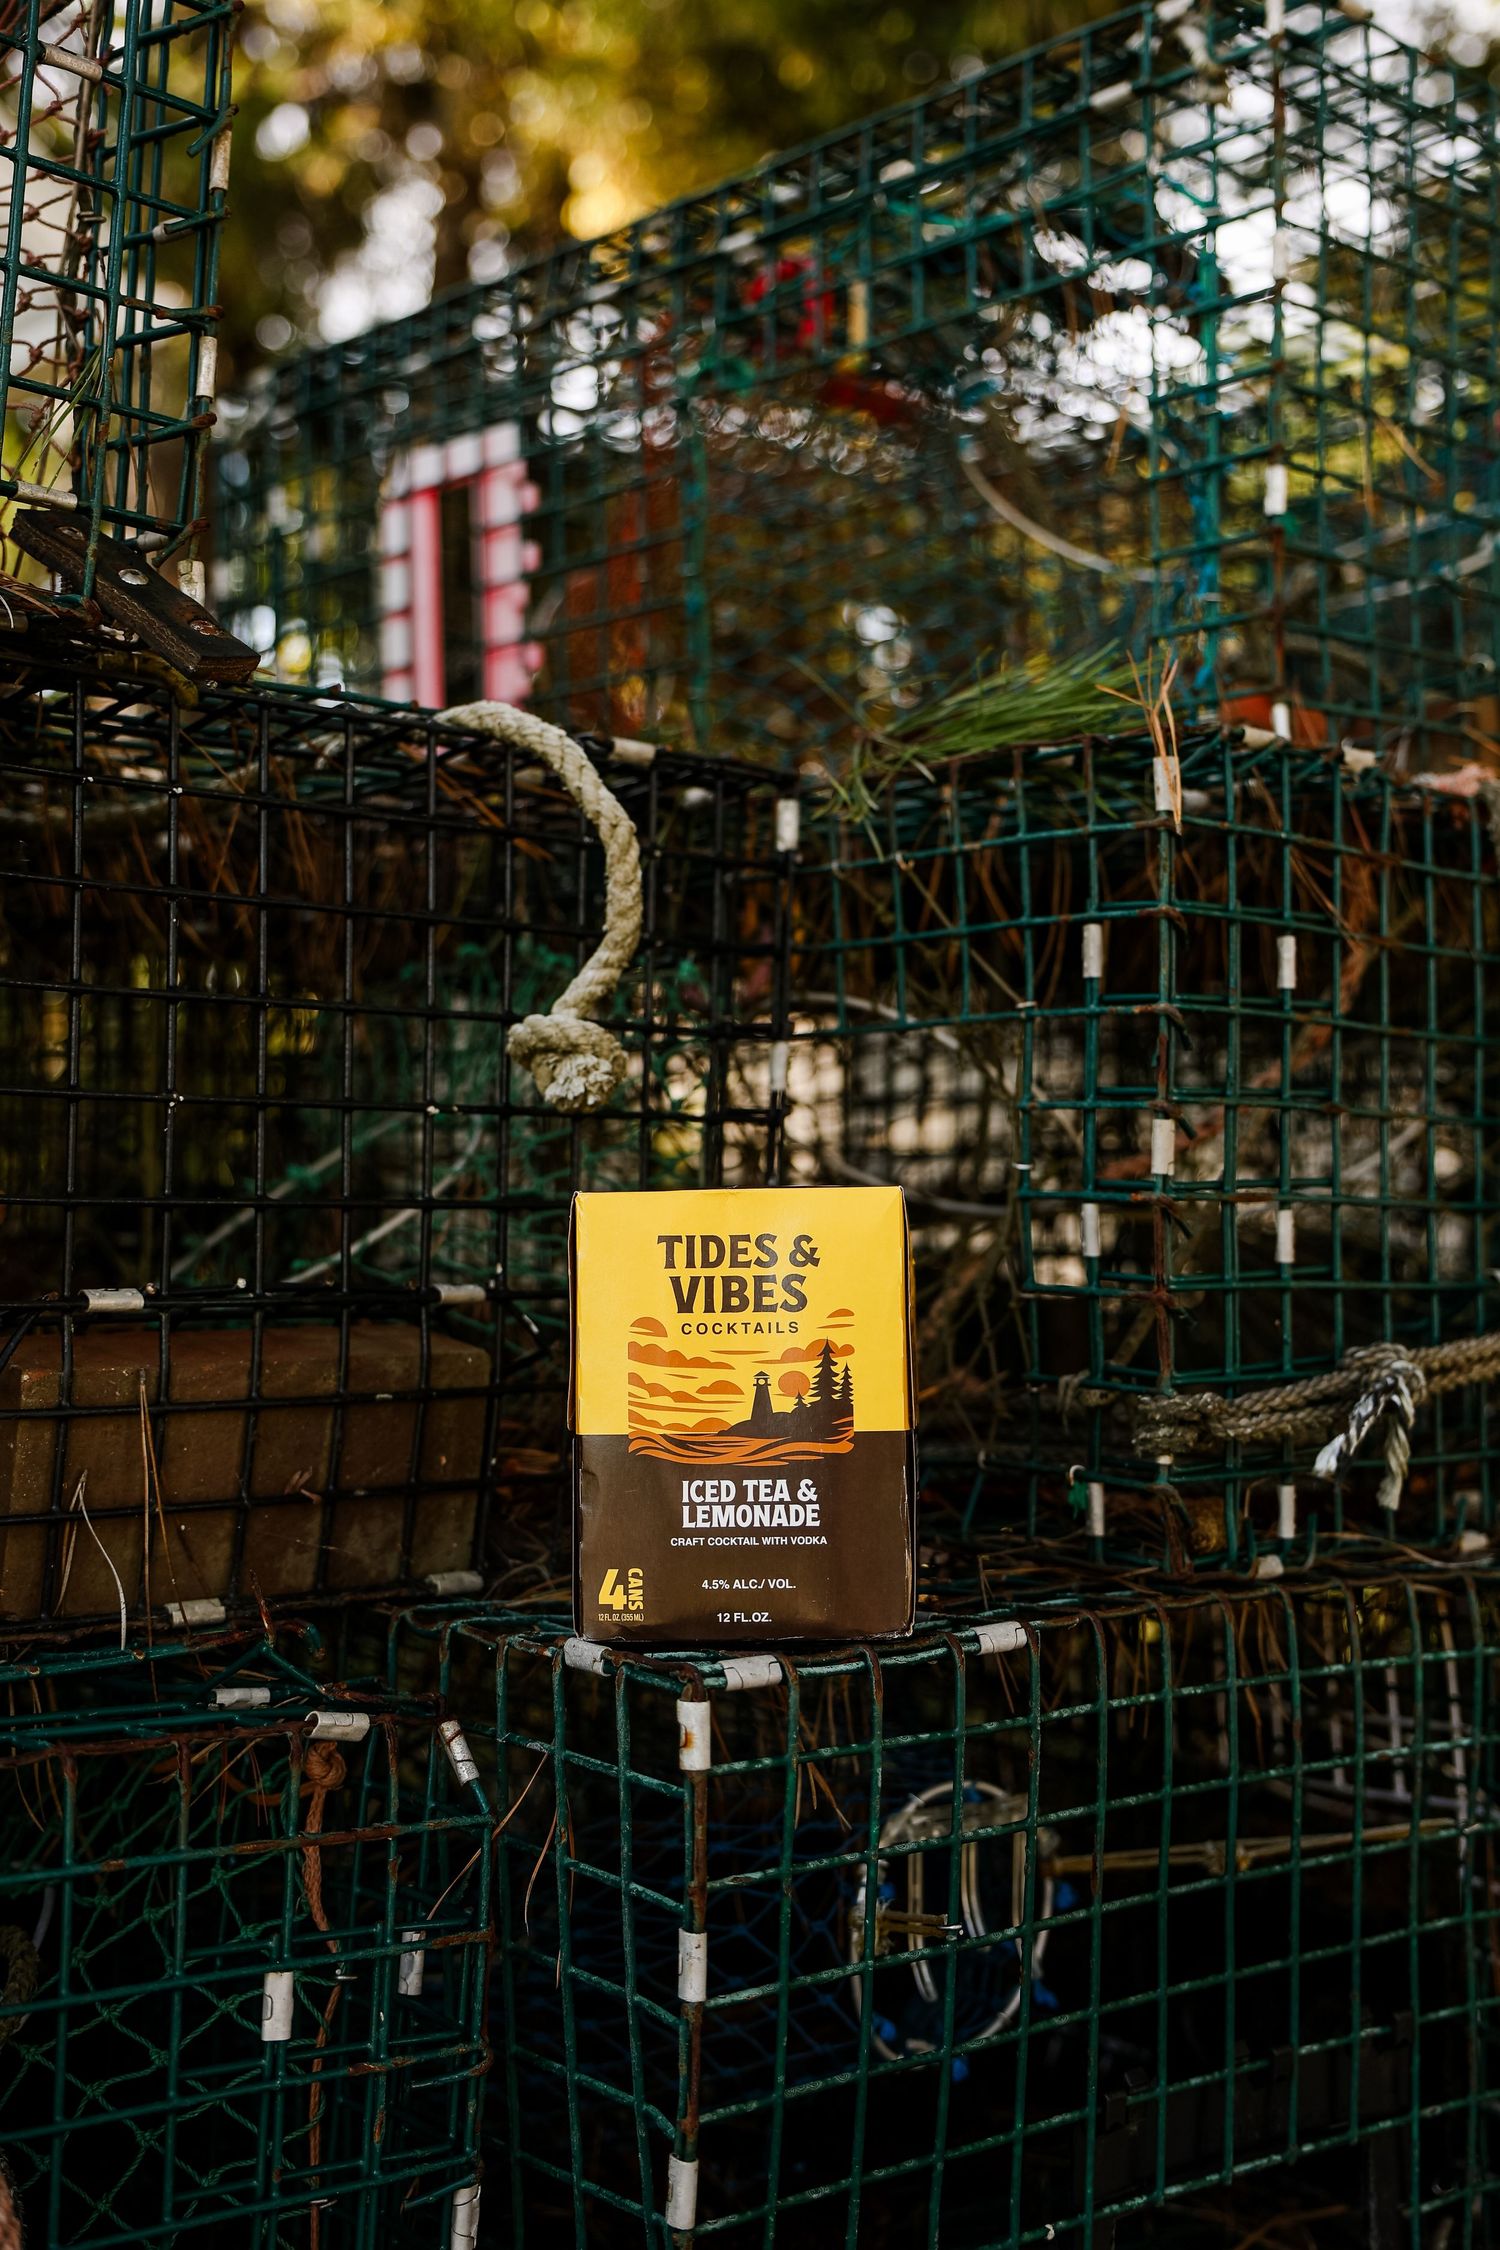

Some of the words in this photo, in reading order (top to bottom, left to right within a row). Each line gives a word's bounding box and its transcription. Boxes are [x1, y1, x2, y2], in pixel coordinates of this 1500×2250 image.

[657, 1233, 779, 1269] TIDES
[788, 1234, 821, 1268] &
[669, 1274, 808, 1314] VIBES
[681, 1321, 799, 1336] COCKTAILS
[682, 1480, 737, 1503] ICED
[742, 1479, 792, 1502] TEA
[797, 1479, 818, 1502] &
[682, 1503, 821, 1528] LEMONADE
[670, 1537, 705, 1546] CRAFT
[708, 1536, 759, 1546] COCKTAIL
[762, 1536, 788, 1545] WITH
[790, 1535, 827, 1545] VODKA
[598, 1568, 627, 1610] 4
[628, 1568, 644, 1611] CANS
[701, 1579, 730, 1589] 4.5%
[768, 1578, 796, 1589] VOL.
[598, 1613, 604, 1622] 12
[717, 1612, 731, 1622] 12
